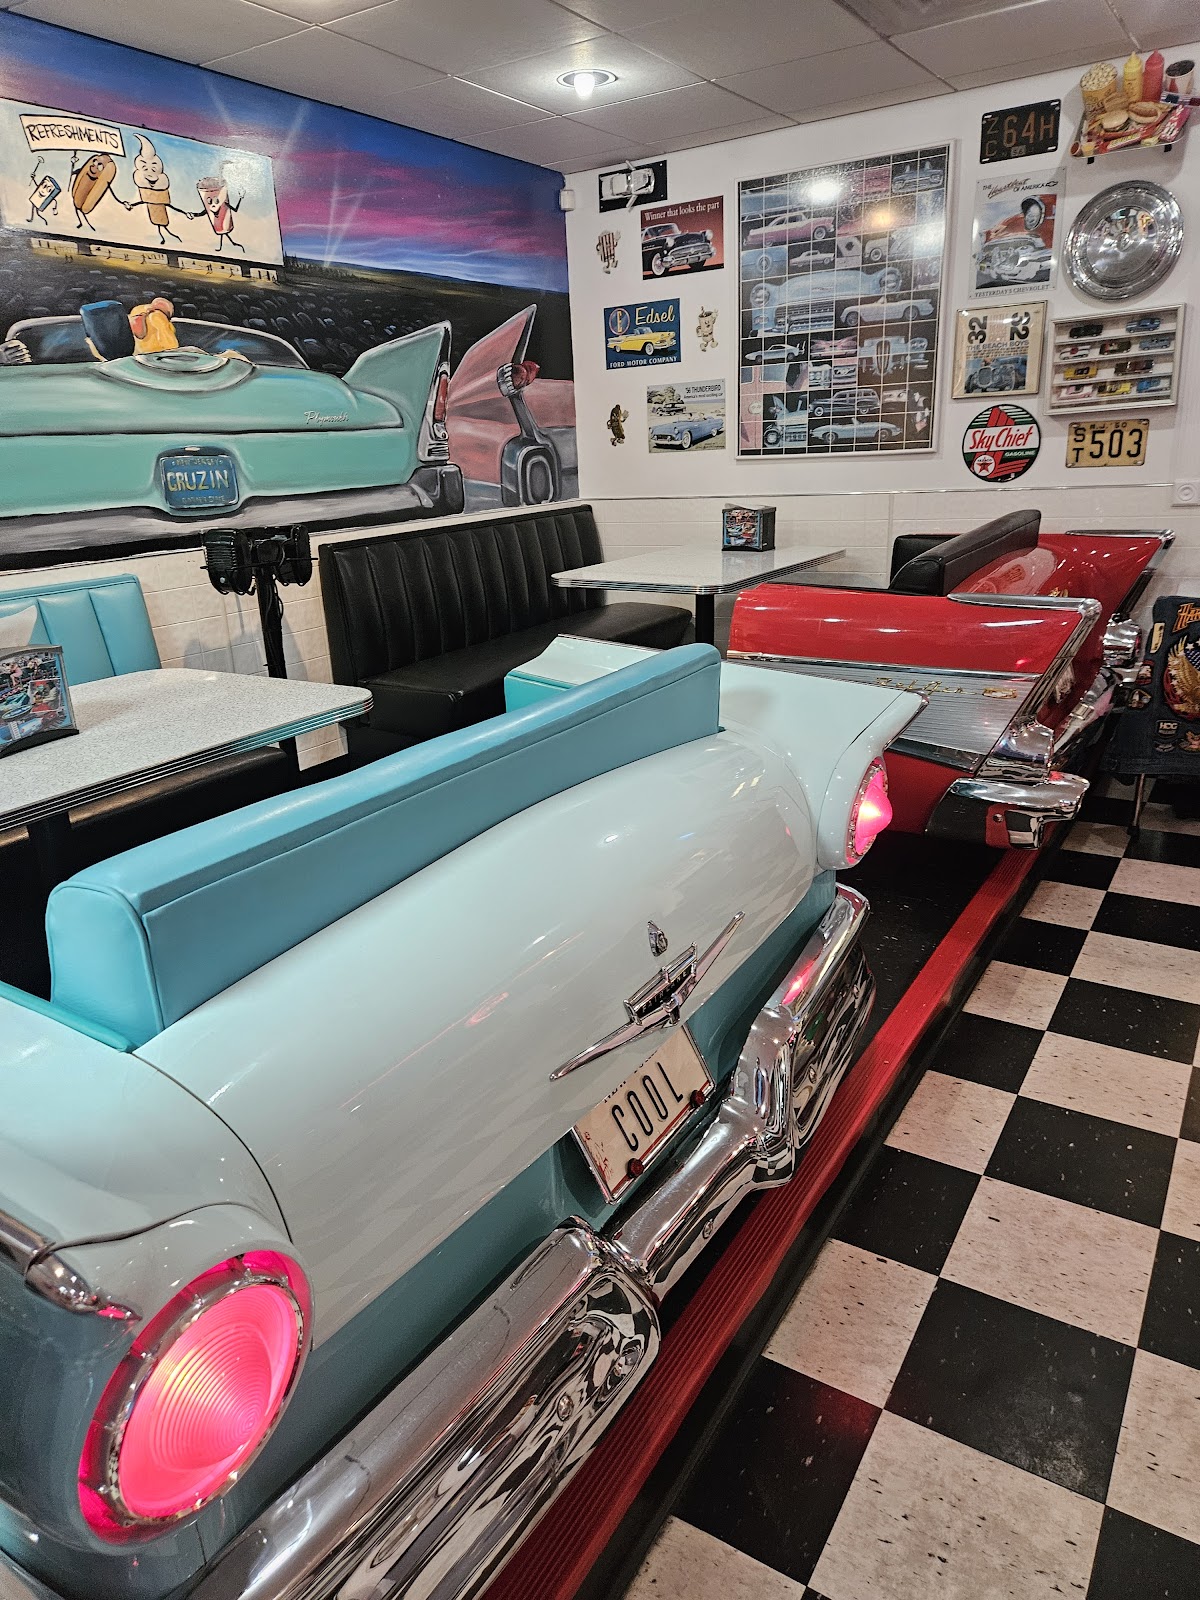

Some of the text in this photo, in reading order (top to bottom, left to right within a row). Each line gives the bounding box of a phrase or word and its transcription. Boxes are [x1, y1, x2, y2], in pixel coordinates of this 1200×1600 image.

[26, 124, 119, 149] REFRESHMENTS
[645, 202, 720, 221] Winner that looks the part
[975, 284, 1050, 298] YESTERDAY'S CHEVROLET
[635, 305, 675, 326] Edsel
[982, 342, 1008, 350] BEACH
[1009, 339, 1030, 347] BOYS
[610, 355, 678, 369] FORD MOTOR COMPANY
[692, 384, 721, 393] THUNDERBIRD
[303, 410, 349, 427] Plymouth
[969, 426, 1034, 452] Sky Chief
[1089, 428, 1143, 459] 503
[166, 469, 230, 492] CRUZIN
[1159, 722, 1179, 730] HOG
[611, 1062, 684, 1152] COOL
